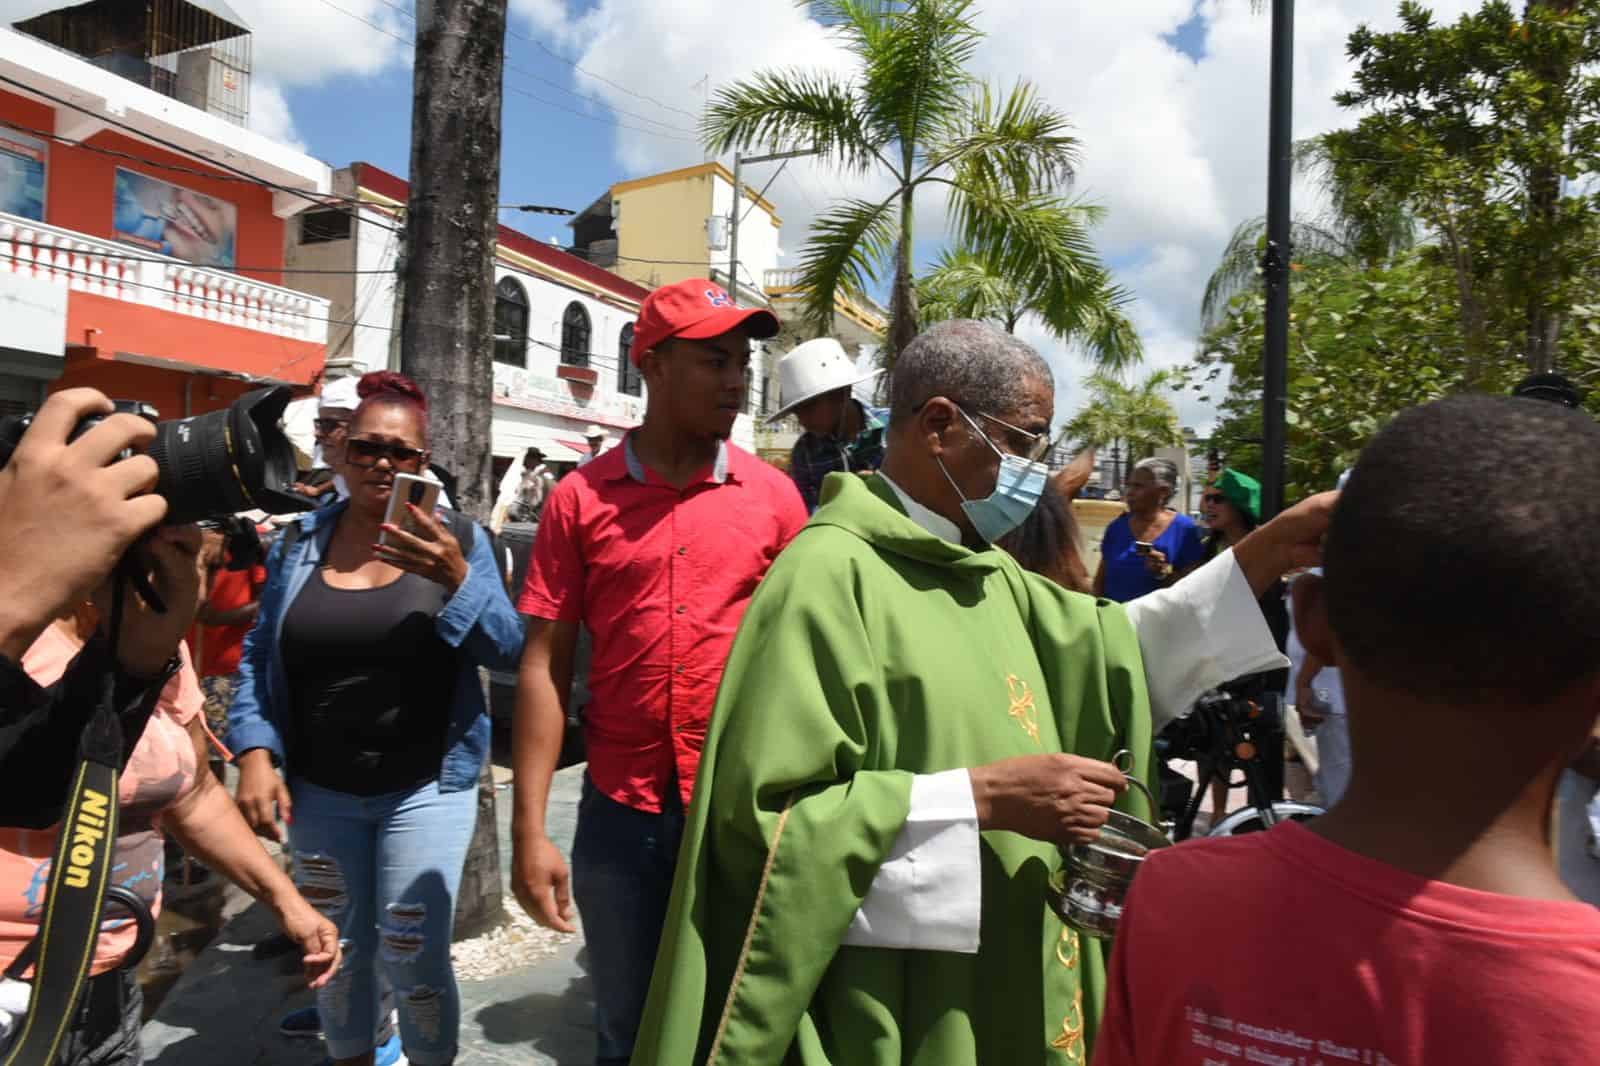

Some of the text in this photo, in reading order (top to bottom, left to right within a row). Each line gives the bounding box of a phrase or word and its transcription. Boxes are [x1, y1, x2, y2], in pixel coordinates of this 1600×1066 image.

[64, 788, 109, 889] Nikon
[1214, 1039, 1241, 1056] one
[1236, 1023, 1313, 1050] consider
[1317, 1039, 1360, 1061] that
